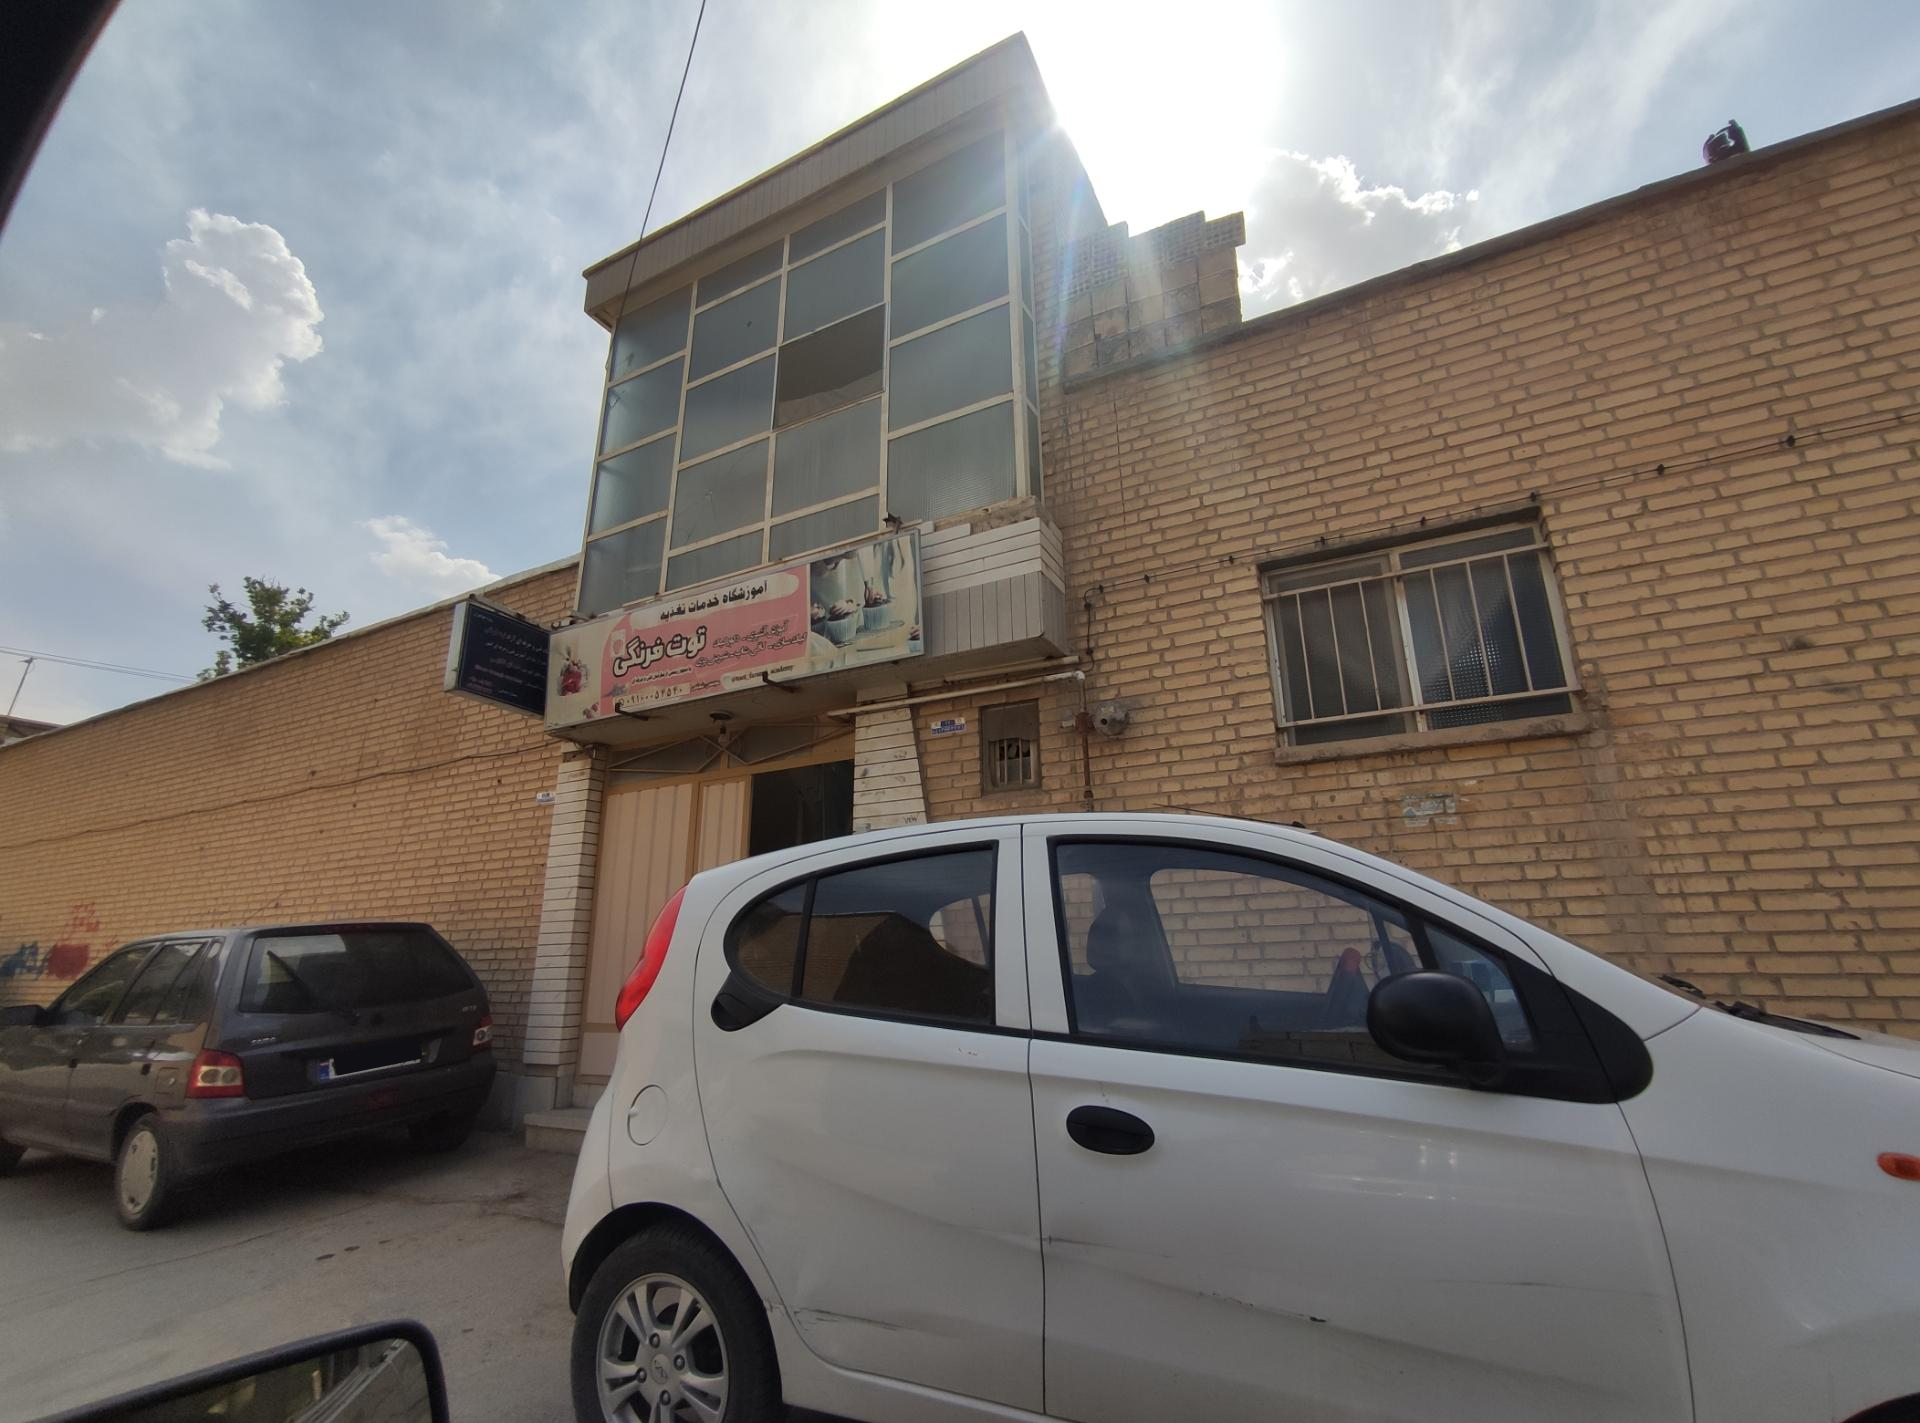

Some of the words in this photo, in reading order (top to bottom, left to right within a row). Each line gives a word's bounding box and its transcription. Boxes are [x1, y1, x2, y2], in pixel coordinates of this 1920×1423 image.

[660, 603, 686, 621] تغذیه
[688, 594, 720, 613] خدمات
[667, 625, 707, 659] توت
[613, 636, 664, 676] فرنگی
